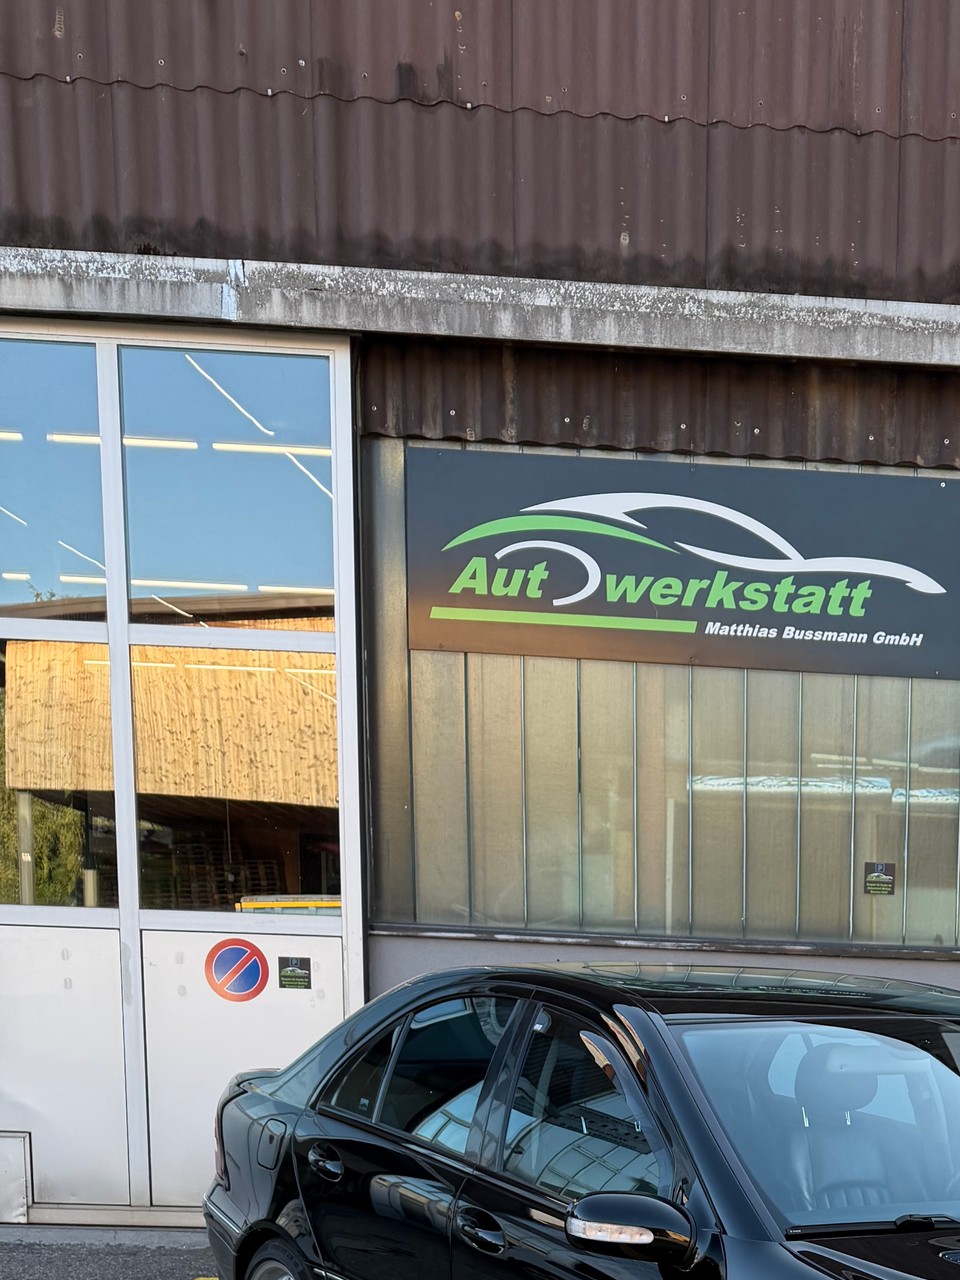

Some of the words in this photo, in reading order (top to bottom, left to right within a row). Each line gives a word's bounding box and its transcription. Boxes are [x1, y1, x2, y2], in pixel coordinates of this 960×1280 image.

[705, 621, 778, 638] Matthias
[782, 626, 868, 643] Bussmann
[872, 631, 924, 647] GmbH
